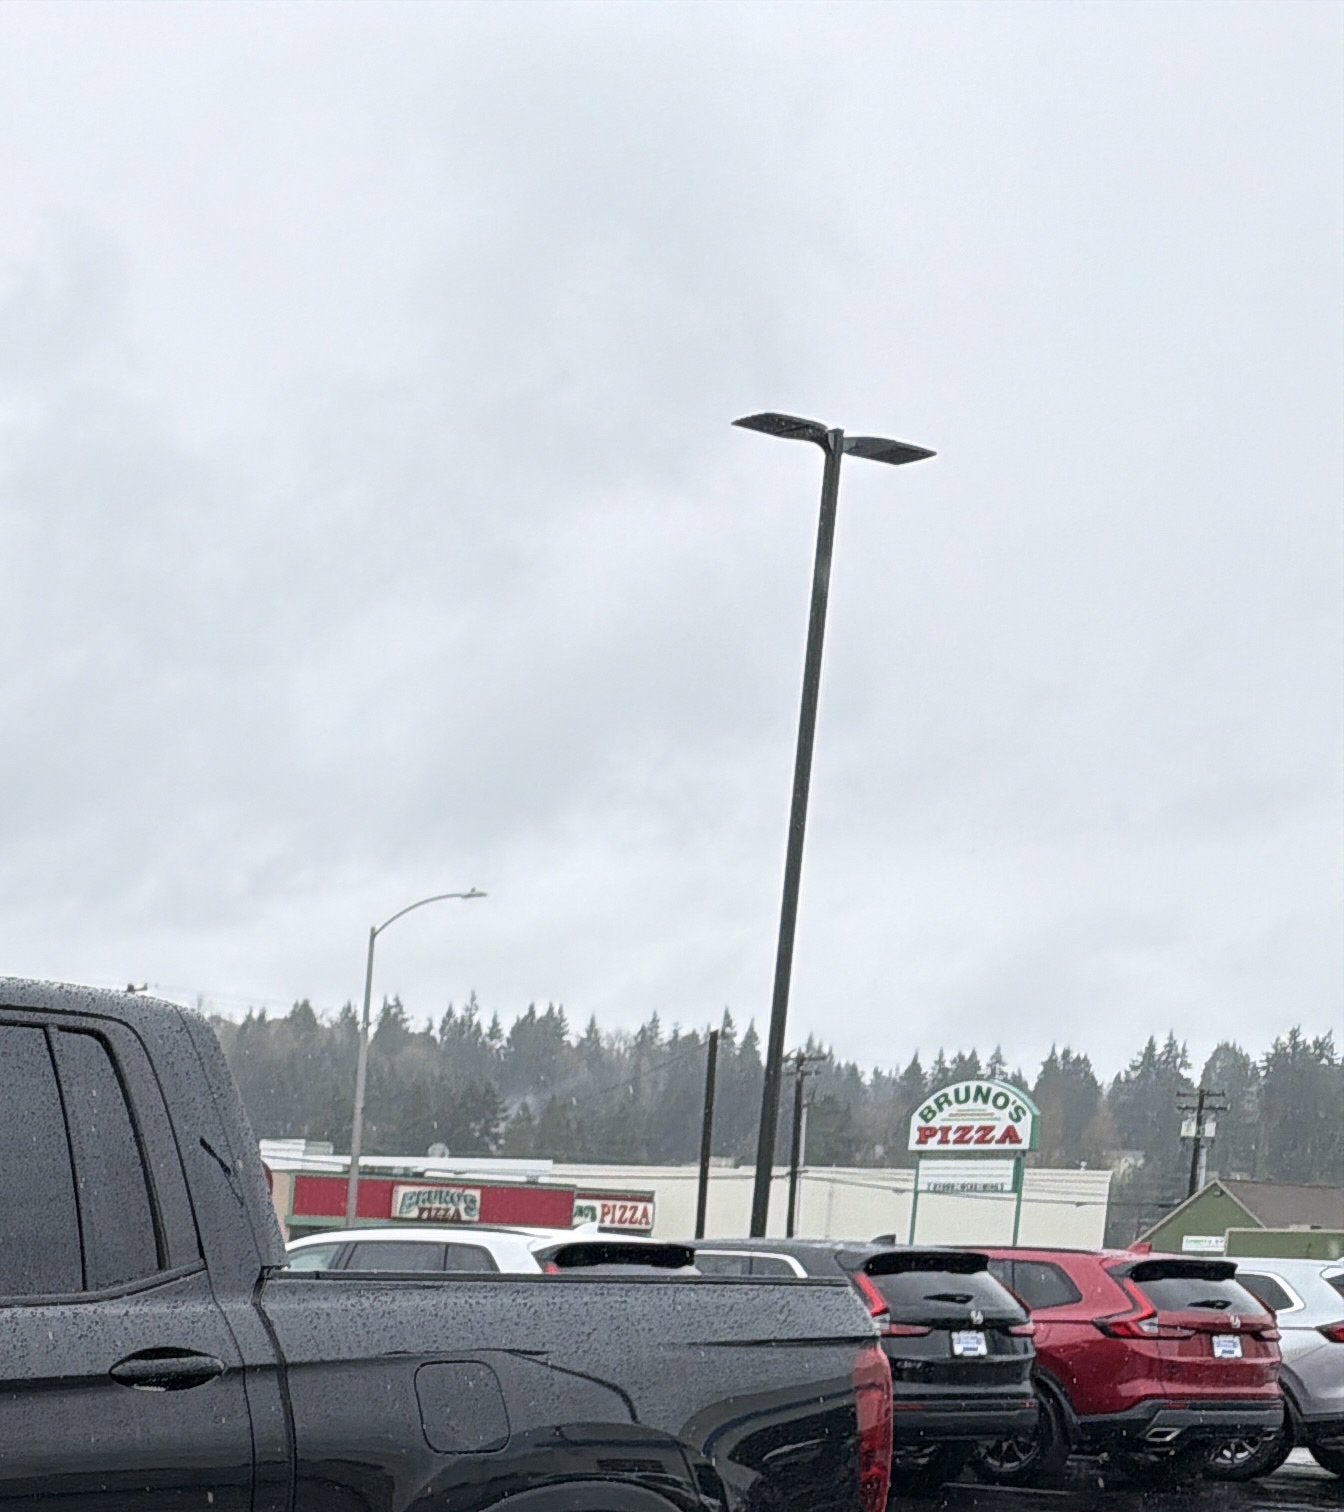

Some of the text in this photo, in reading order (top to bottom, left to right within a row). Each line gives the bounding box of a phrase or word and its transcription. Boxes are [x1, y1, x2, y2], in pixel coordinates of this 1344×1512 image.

[918, 1085, 1027, 1124] BRUNO'S
[915, 1124, 1023, 1145] PIZZA
[599, 1203, 651, 1226] PIZZA
